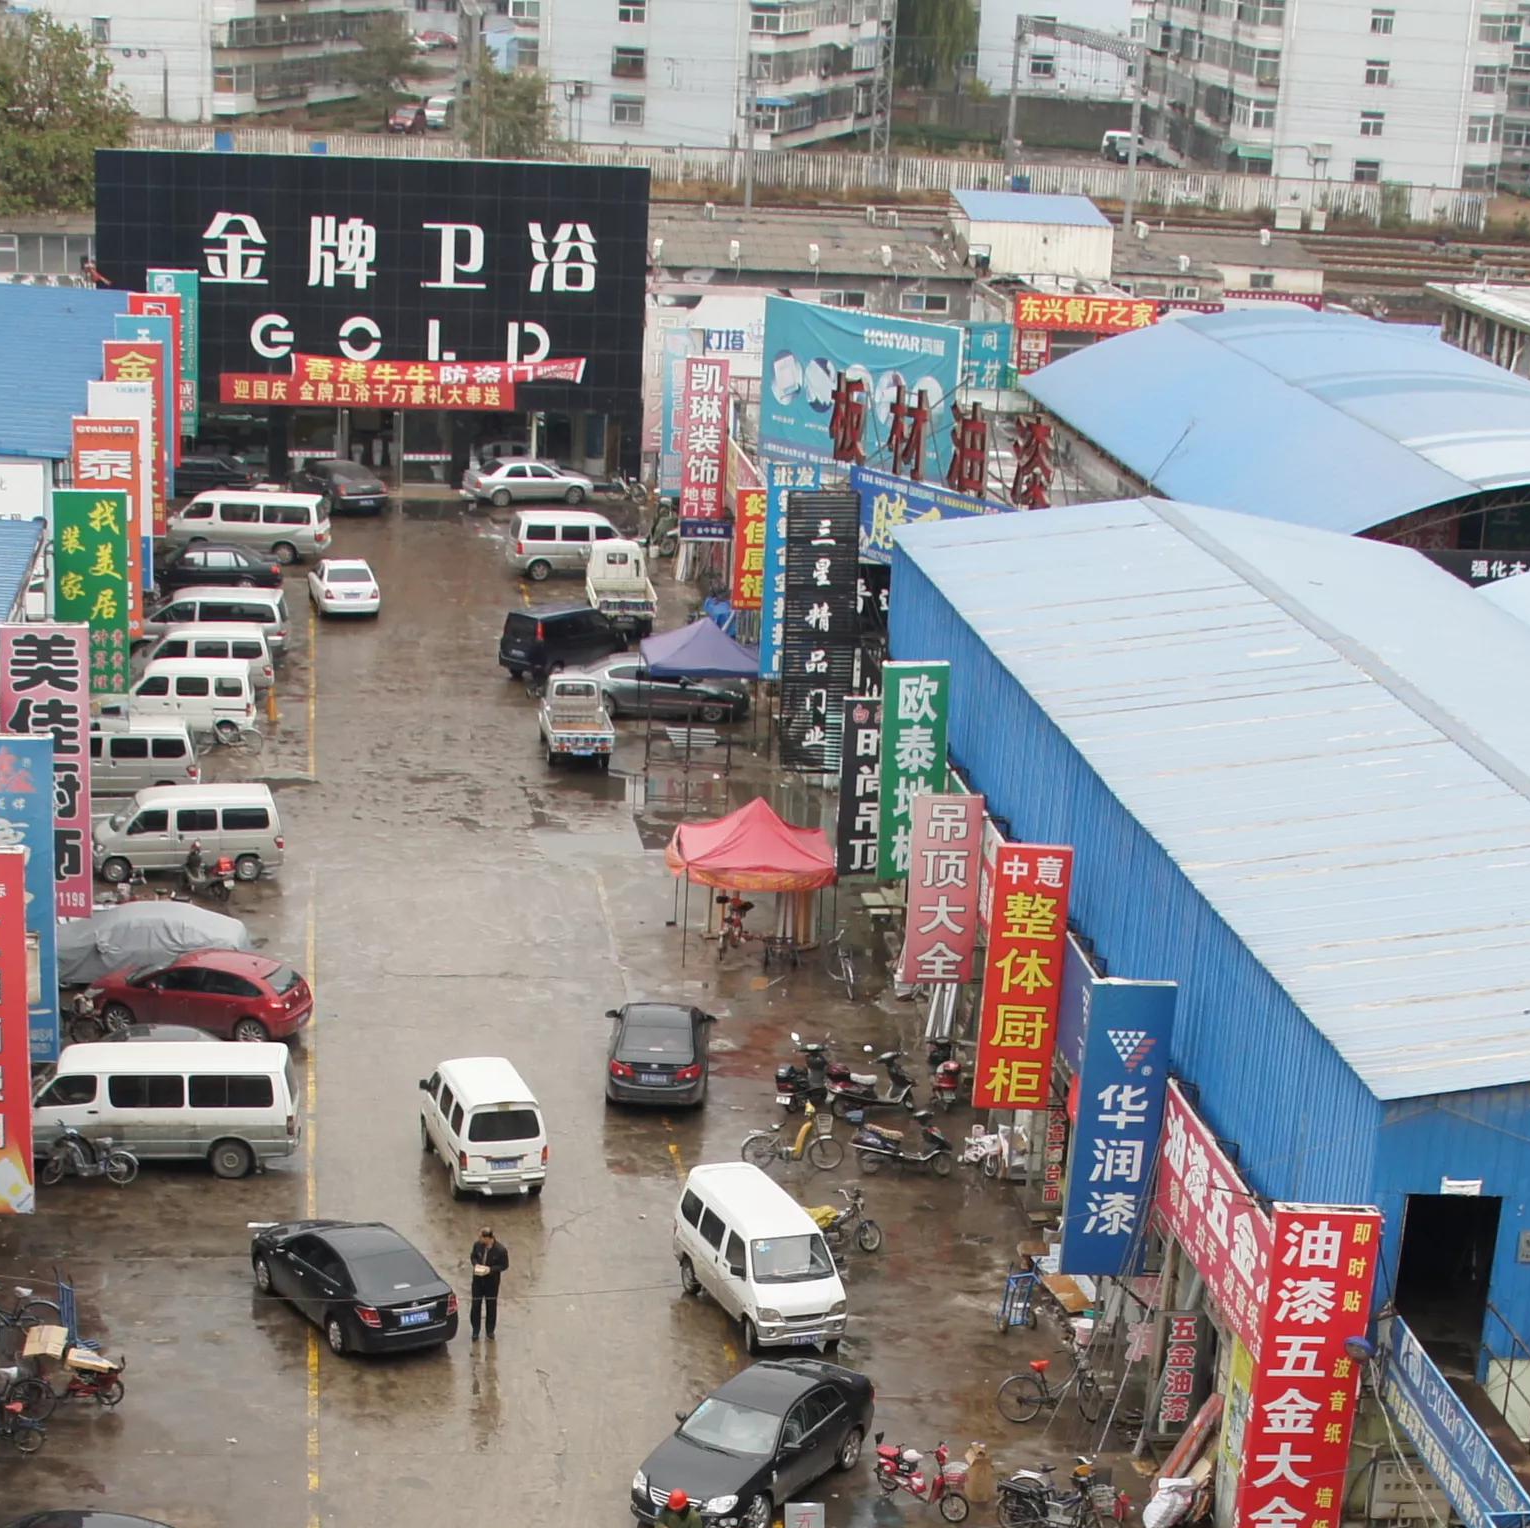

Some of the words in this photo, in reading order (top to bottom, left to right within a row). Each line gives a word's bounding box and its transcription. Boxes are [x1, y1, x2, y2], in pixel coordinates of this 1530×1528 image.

[200, 212, 597, 292] 金牌卫浴
[251, 314, 550, 362] GOLD
[1019, 297, 1153, 328] 东兴餐厅之家
[234, 380, 287, 400] 迎国庆
[300, 382, 501, 406] 金牌卫浴千万豪礼大奉送
[688, 362, 726, 486] 凯琳装饰
[774, 466, 815, 487] 批发
[801, 519, 837, 748] 三星精品门业
[916, 803, 971, 981] 吊顶大全
[1001, 855, 1066, 889] 中意
[984, 892, 1061, 1106] 整体厨柜
[1083, 1083, 1150, 1236] 华润漆
[1342, 1222, 1373, 1315] 即时贴
[1161, 1315, 1199, 1424] 五金油漆
[1323, 1356, 1352, 1445] 波音纸
